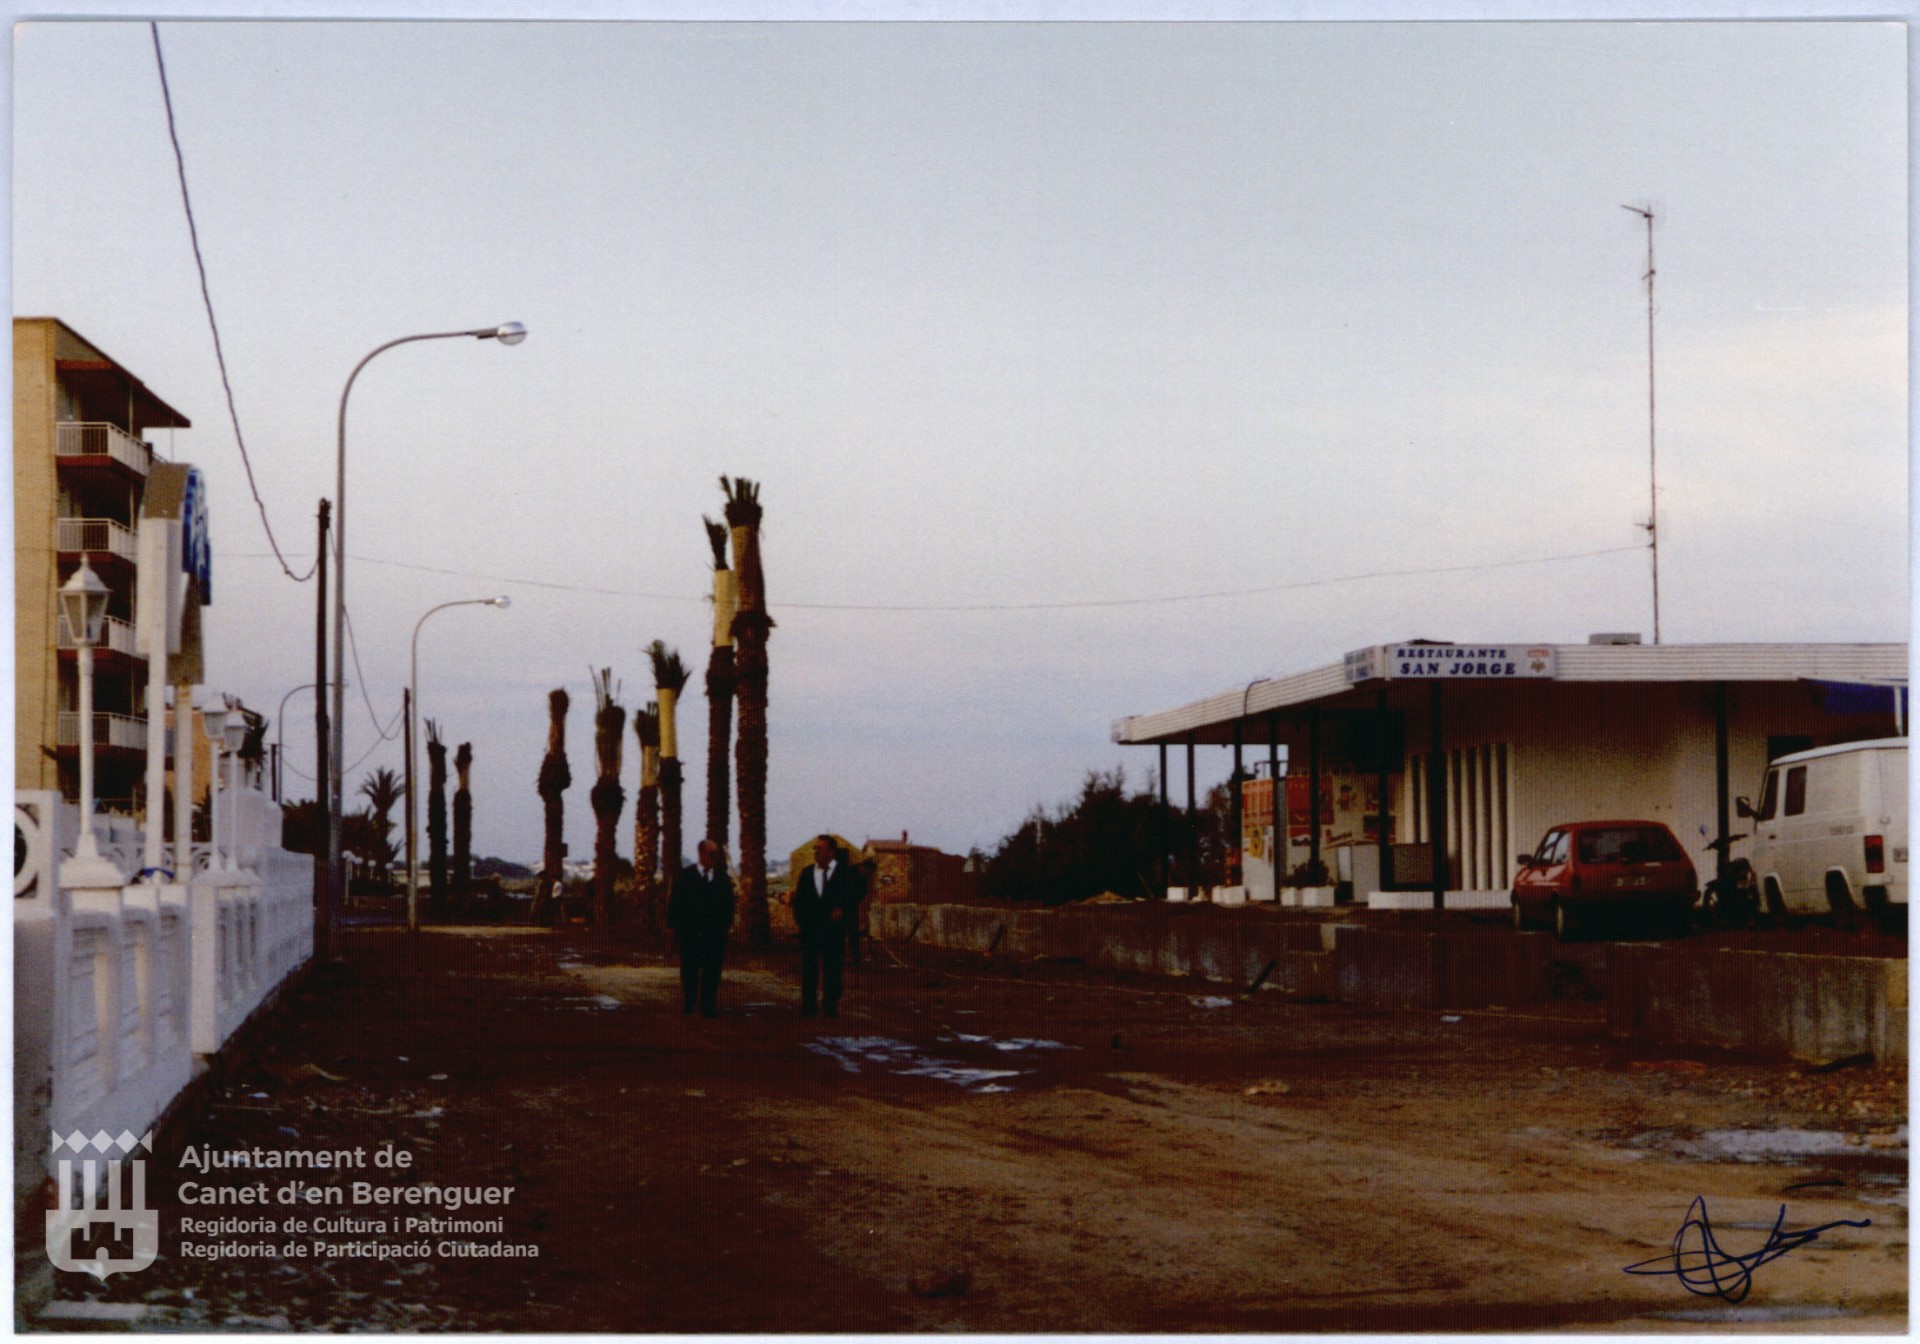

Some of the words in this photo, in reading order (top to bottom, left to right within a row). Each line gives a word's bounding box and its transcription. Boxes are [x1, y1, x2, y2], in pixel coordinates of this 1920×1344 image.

[1397, 649, 1507, 659] RESTAURANTE
[1400, 662, 1440, 676] SAN
[1450, 662, 1516, 676] JORGE
